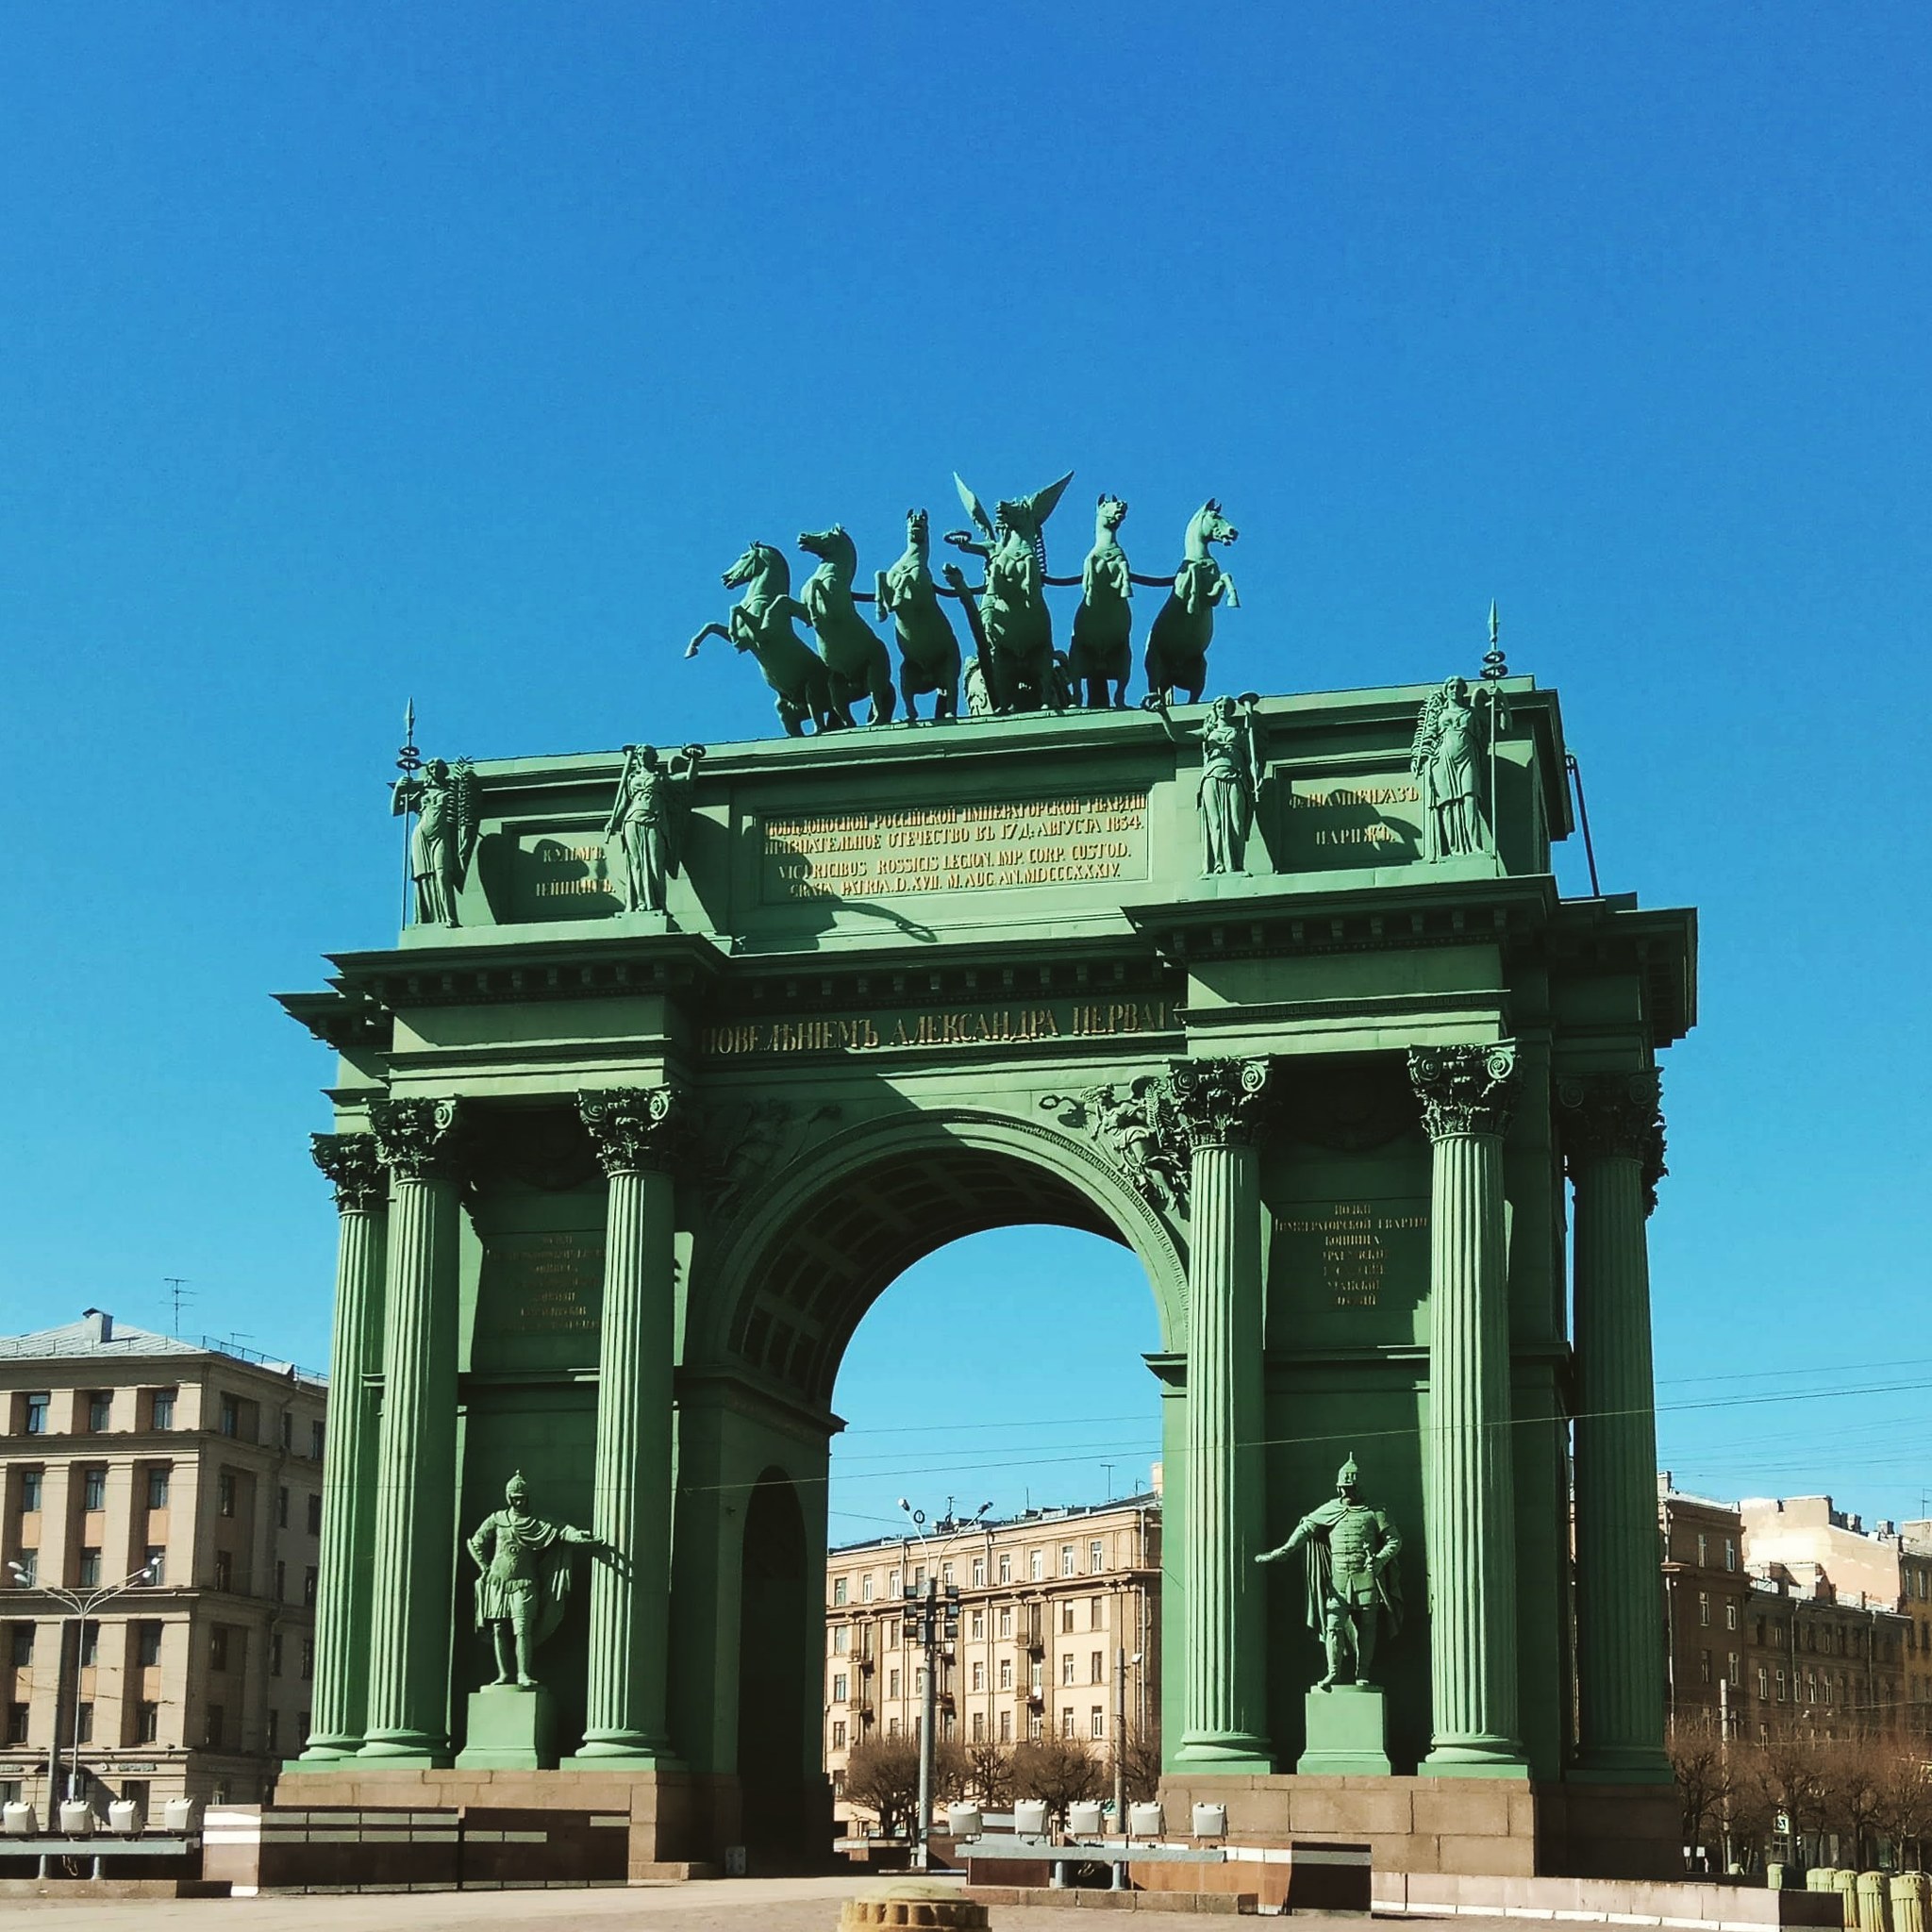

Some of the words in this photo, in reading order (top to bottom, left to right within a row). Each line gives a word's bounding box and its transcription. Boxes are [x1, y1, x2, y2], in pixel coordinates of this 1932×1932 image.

[887, 828, 970, 848] ОТЕЧЕСТВО
[778, 861, 868, 879] VICTRICIBUS
[876, 856, 939, 874] ROSSICIS
[1072, 842, 1131, 861] CUSTOD.
[890, 1008, 1058, 1046] АЛЕКСАНДРА
